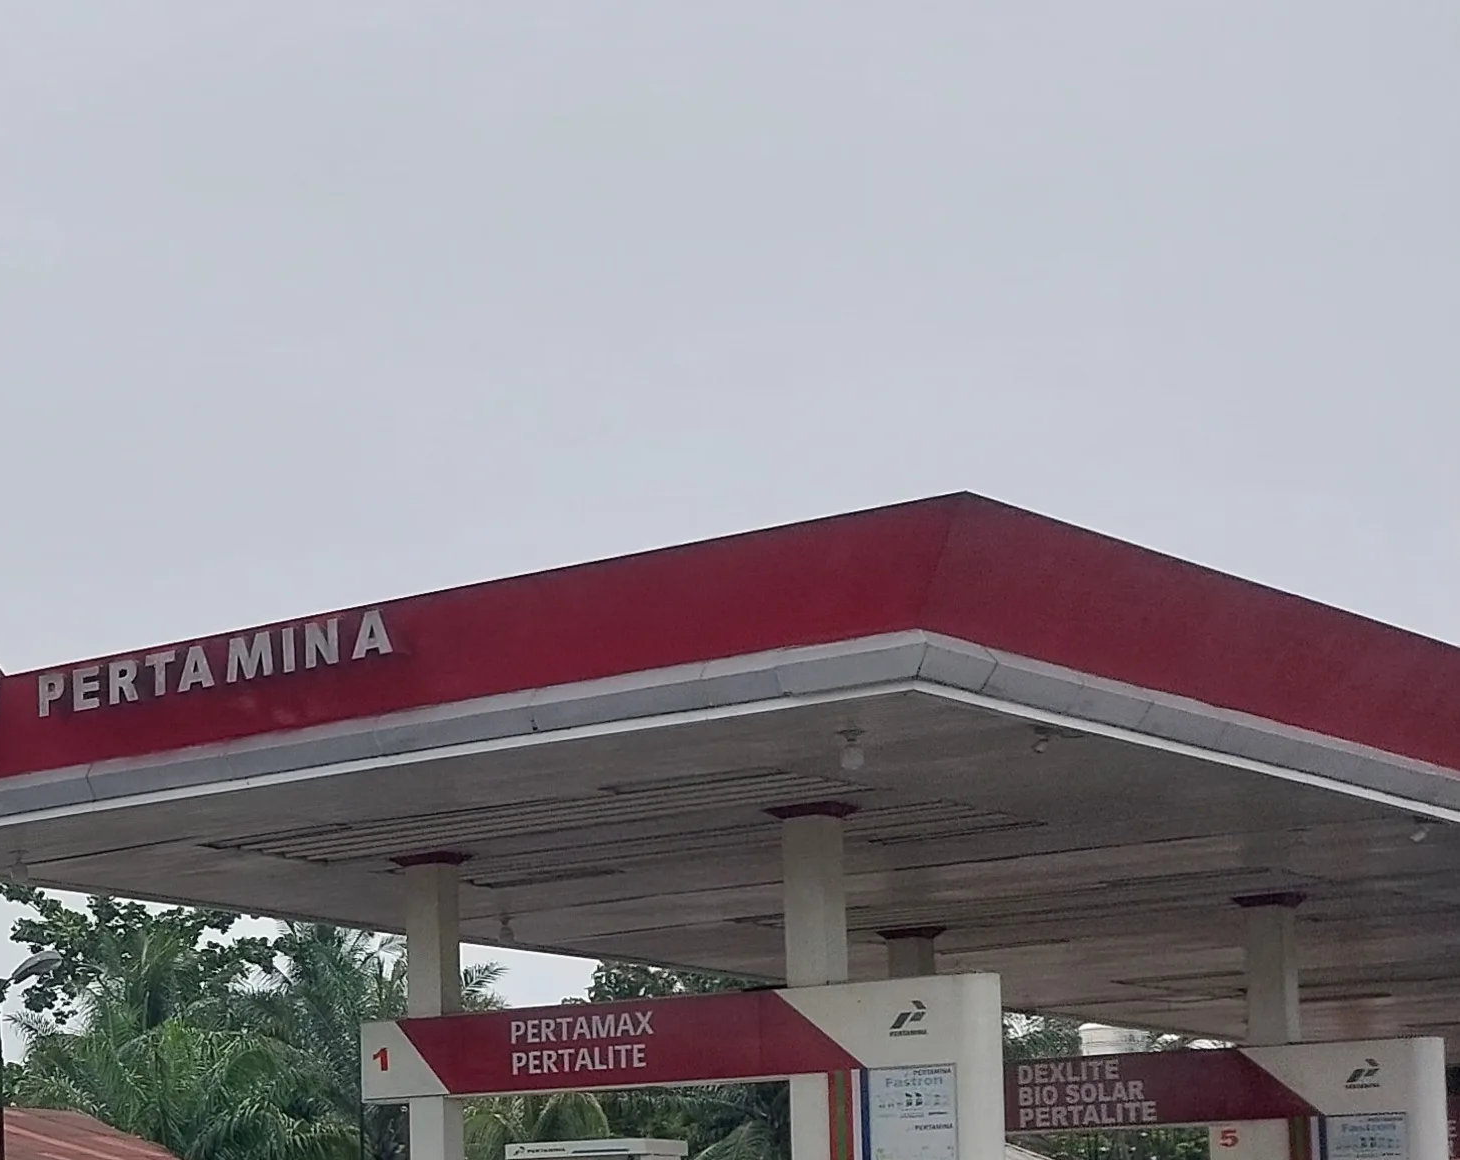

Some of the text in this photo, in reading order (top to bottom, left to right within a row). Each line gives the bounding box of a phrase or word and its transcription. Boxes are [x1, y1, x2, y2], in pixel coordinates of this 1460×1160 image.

[38, 609, 393, 717] PERTAMINA
[510, 1010, 655, 1045] PERTAMAX
[372, 1047, 390, 1072] 1
[511, 1043, 647, 1076] PERTALITE
[1017, 1059, 1120, 1085] DEXLITE
[885, 1077, 943, 1088] Fastron
[1017, 1080, 1145, 1107] BIO SOLAR
[1018, 1101, 1158, 1129] PERTALITE
[1219, 1129, 1239, 1148] 5
